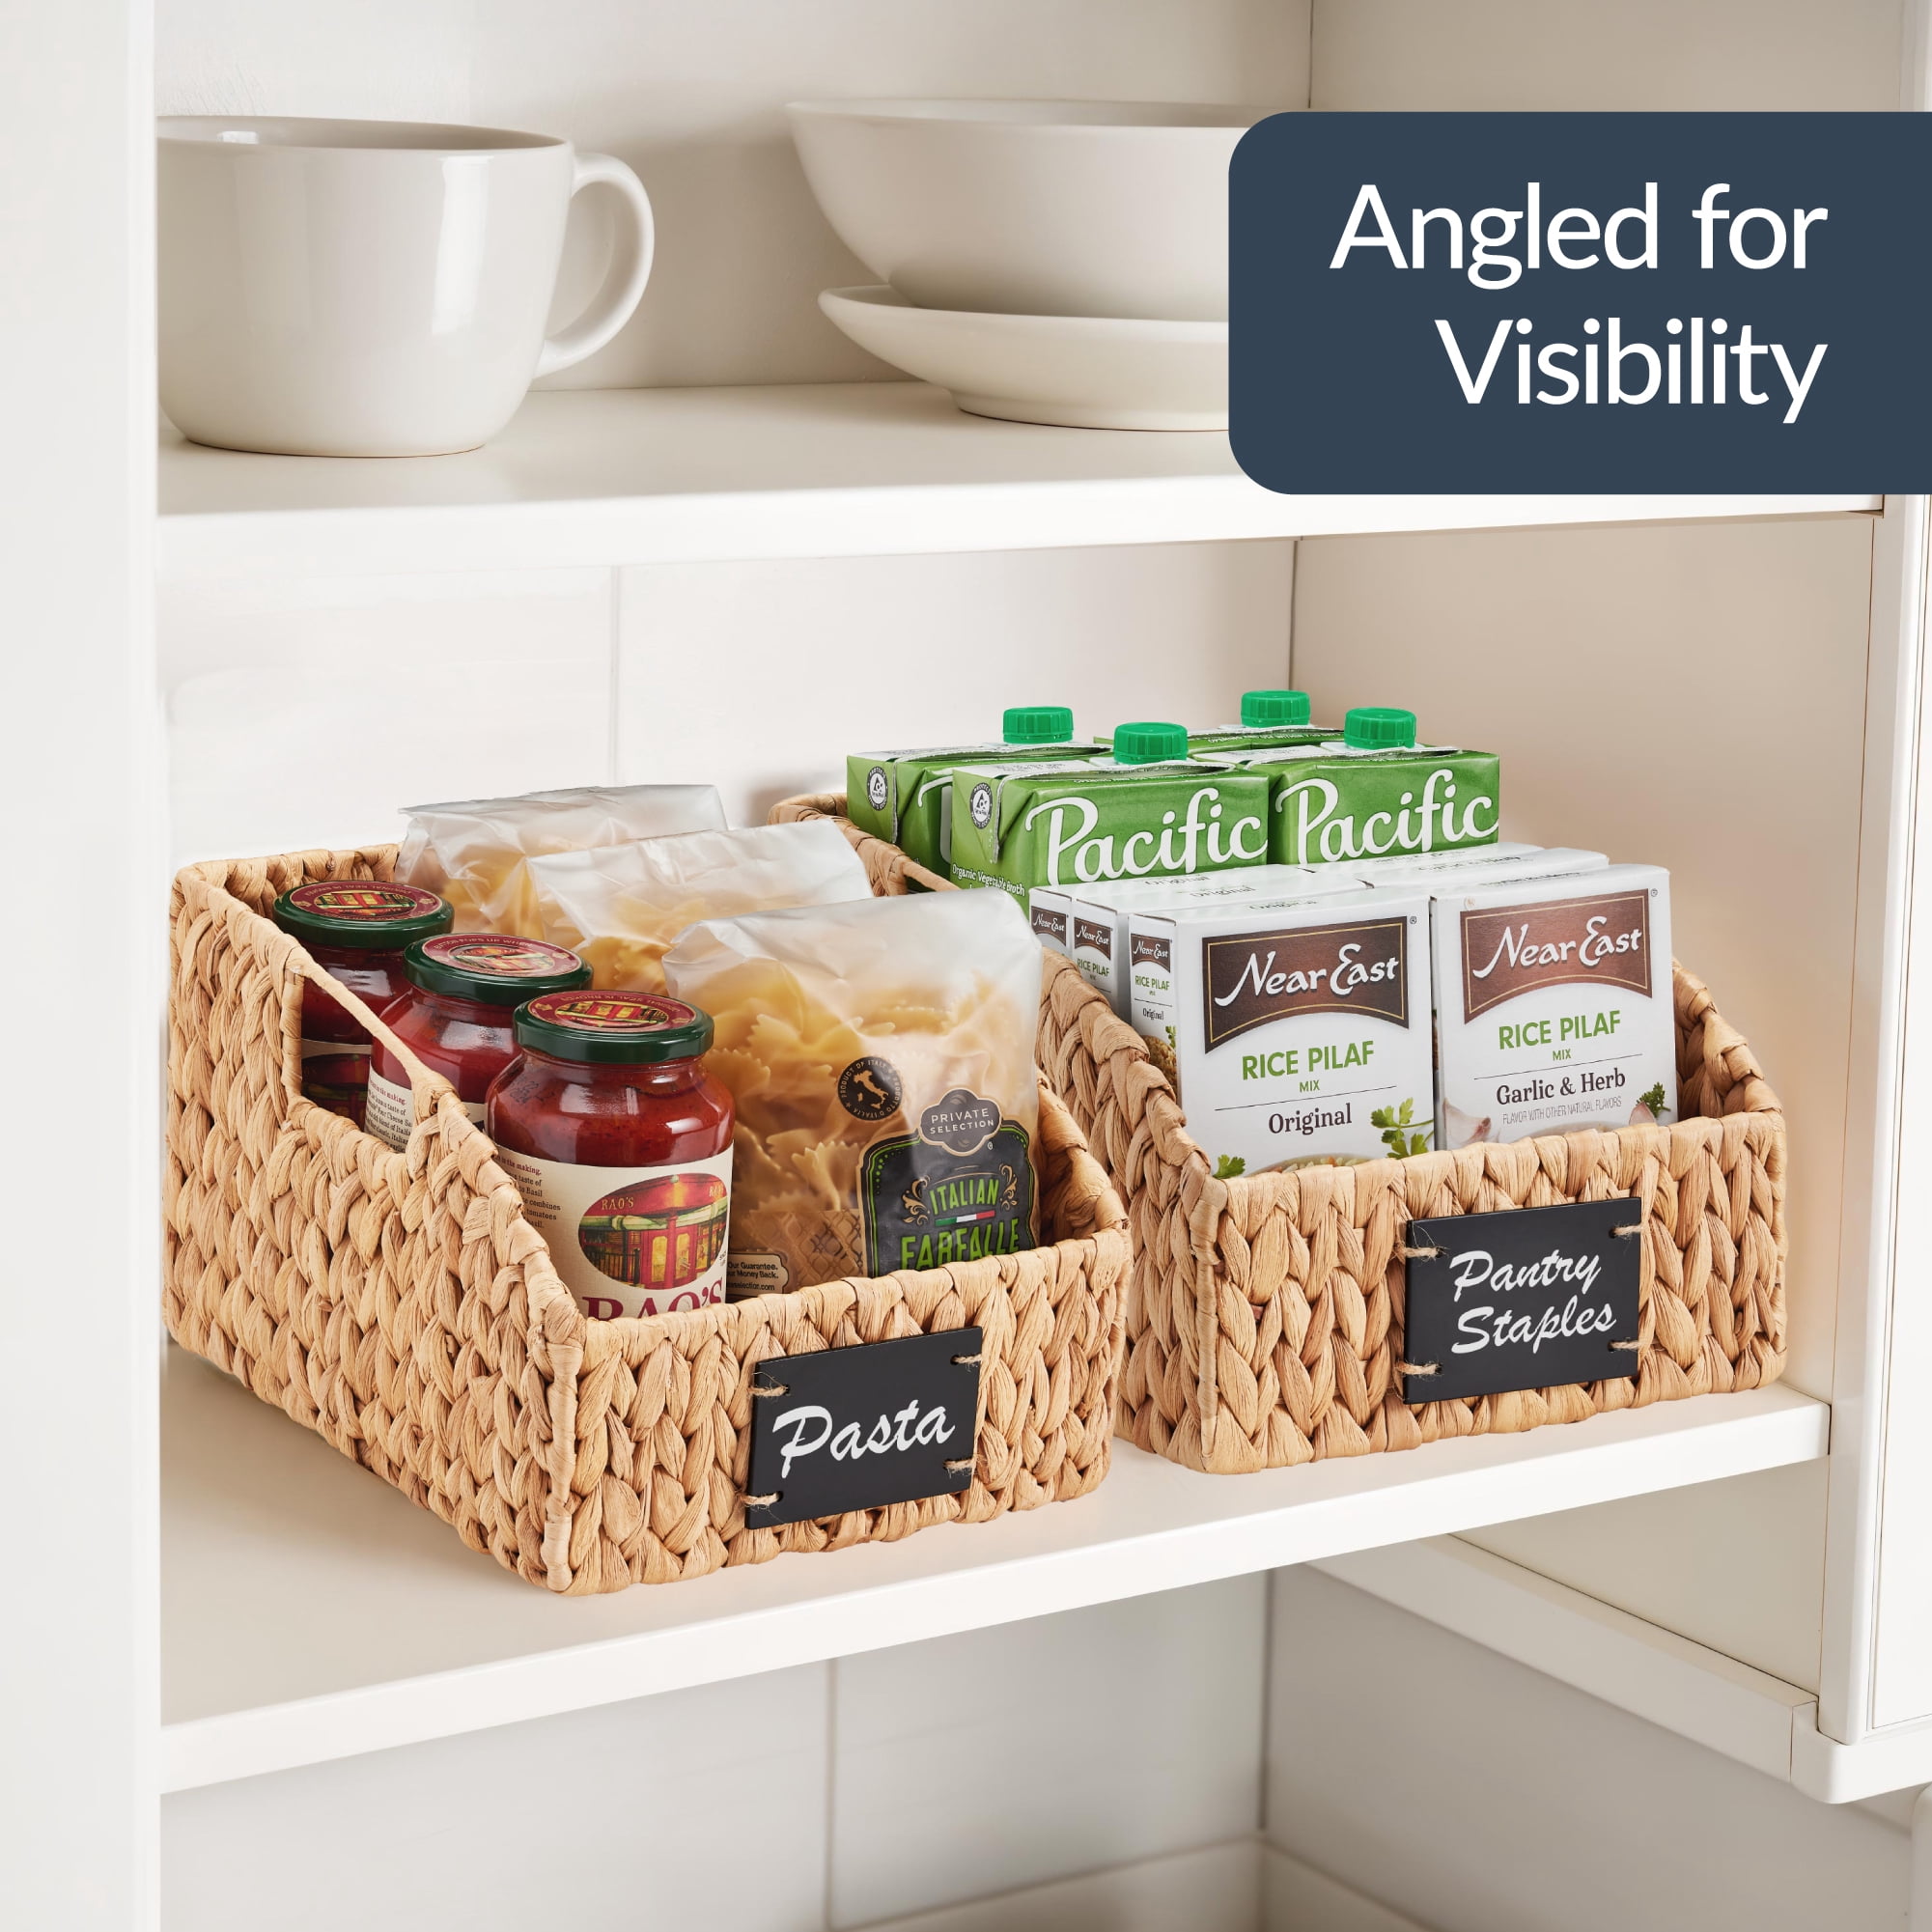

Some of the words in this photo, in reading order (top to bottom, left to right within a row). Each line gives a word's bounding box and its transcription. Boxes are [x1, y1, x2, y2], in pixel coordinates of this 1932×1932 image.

[1274, 769, 1499, 864] Pacific
[1025, 787, 1269, 885] Pacific
[952, 863, 977, 880] Organic
[978, 871, 1006, 889] Vegetable
[1006, 881, 1025, 896] Broth
[1033, 913, 1052, 928] Near
[1051, 918, 1065, 932] East
[1077, 924, 1096, 940] Near
[1096, 931, 1109, 944] East
[1133, 940, 1154, 956] Near
[1154, 943, 1168, 959] East
[1472, 923, 1578, 980] Near
[1578, 915, 1642, 967] East
[1078, 958, 1091, 971] RICE
[1092, 963, 1109, 976] PILAF
[1214, 950, 1327, 1007] Near
[1329, 942, 1400, 996] East
[1134, 975, 1150, 988] RICE
[1151, 978, 1170, 991] PILAF
[1142, 1007, 1164, 1021] Original
[1498, 1021, 1552, 1050] RICE
[1560, 1010, 1622, 1042] PILAF
[1242, 1050, 1299, 1080] RICE
[1308, 1040, 1375, 1074] PILAF
[1552, 1049, 1572, 1061] MIX
[1299, 1080, 1321, 1093] MIX
[1496, 1078, 1554, 1106] Garlic
[1559, 1076, 1576, 1096] &
[1581, 1067, 1626, 1093] Herb
[931, 1108, 990, 1124] PRIVATE
[1268, 1103, 1353, 1136] Original
[1502, 1110, 1527, 1125] FLAVOR
[1528, 1108, 1545, 1121] WITH
[1546, 1105, 1567, 1118] OTHER
[1567, 1101, 1595, 1114] NATURAL
[1595, 1096, 1622, 1110] FLAVORS
[930, 1119, 994, 1134] SELECTION
[517, 1163, 542, 1176] making.
[518, 1174, 534, 1184] taste
[526, 1188, 543, 1197] Basil
[929, 1178, 999, 1216] ITALIAN
[529, 1199, 561, 1211] combines
[602, 1196, 634, 1211] RAO'S
[526, 1209, 557, 1220] tomatoes
[900, 1218, 1020, 1272] FARFALLE
[737, 1270, 758, 1279] Money
[759, 1271, 779, 1279] Back.
[741, 1261, 778, 1271] Guarantee.
[1449, 1248, 1602, 1302] Pantry
[581, 1277, 723, 1322] RAO'S
[1451, 1295, 1617, 1354] Staples
[772, 1399, 956, 1478] Pasta
